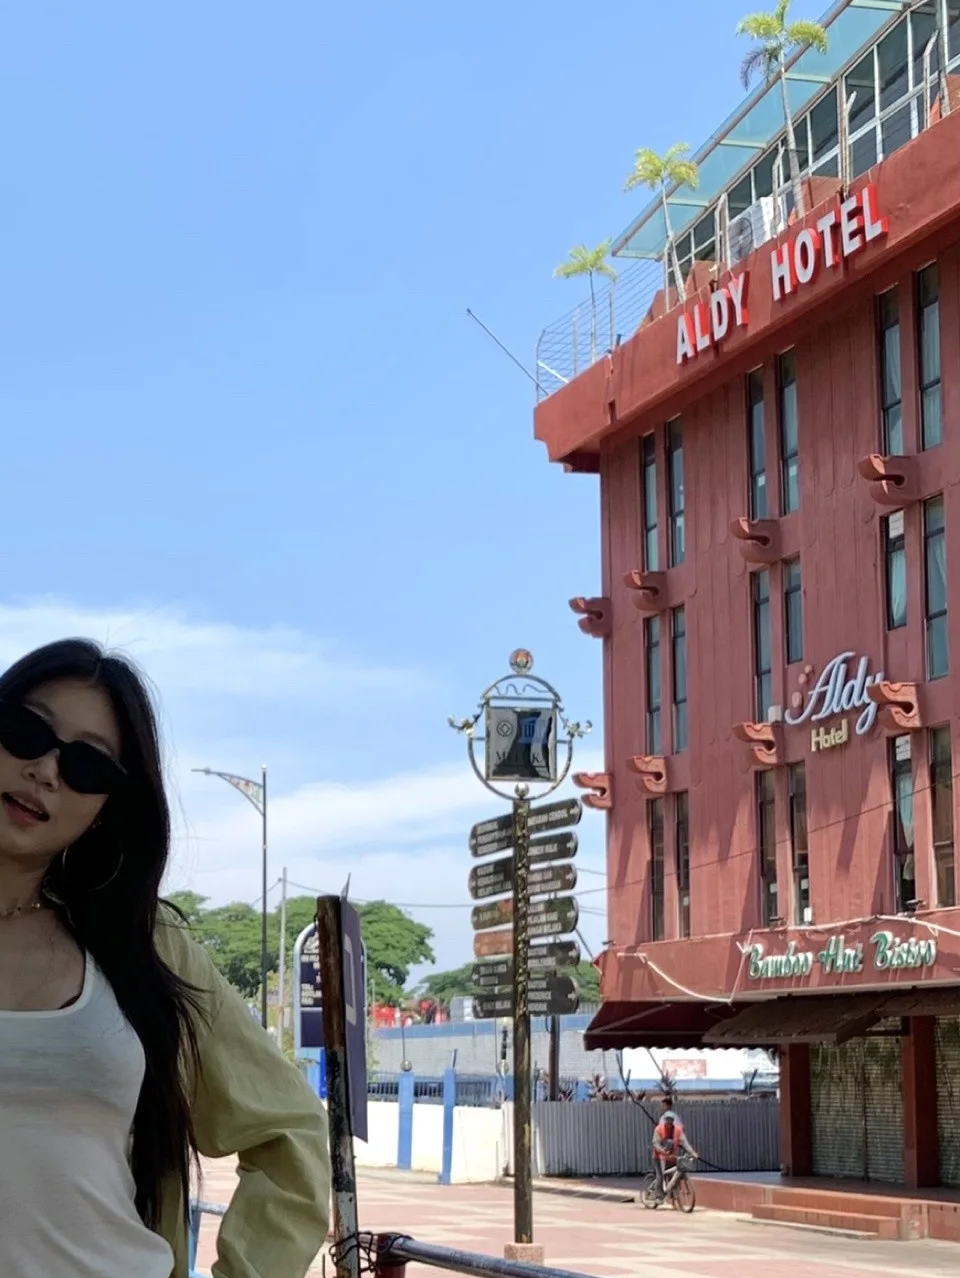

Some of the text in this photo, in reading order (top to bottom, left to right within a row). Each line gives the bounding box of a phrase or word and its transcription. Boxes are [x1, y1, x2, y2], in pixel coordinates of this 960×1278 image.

[677, 183, 888, 365] ALDY HOTEL
[784, 651, 885, 735] Aldy
[811, 718, 848, 752] Hotel
[748, 930, 936, 980] Bamboo Hut Bistro
